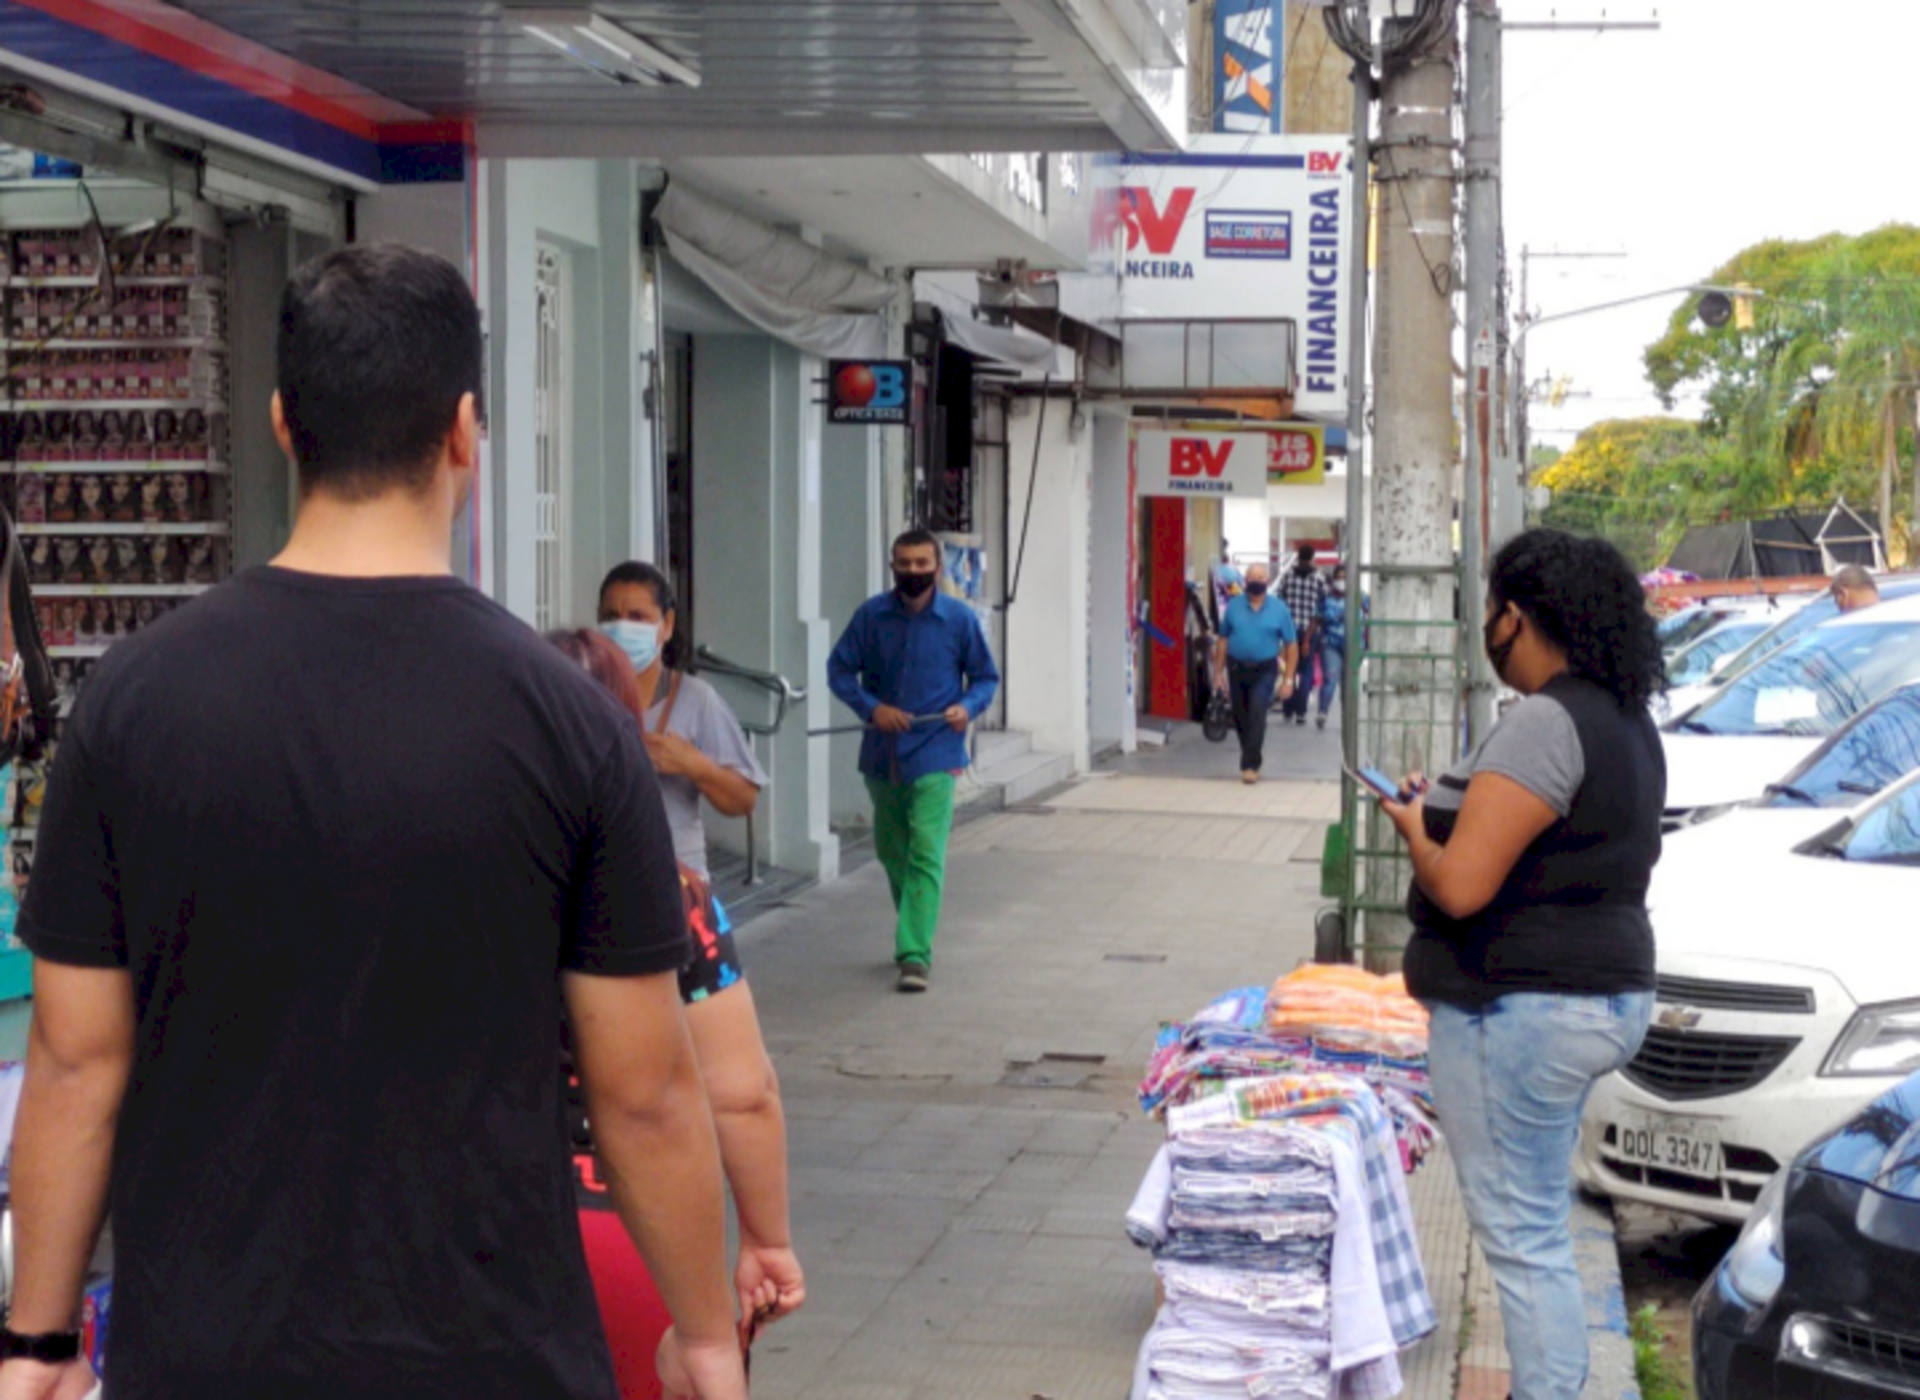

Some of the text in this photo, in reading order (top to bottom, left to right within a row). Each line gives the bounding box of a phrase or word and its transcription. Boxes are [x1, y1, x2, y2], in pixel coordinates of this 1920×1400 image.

[1309, 151, 1342, 171] BV
[1306, 188, 1339, 392] FINANCEIRA
[1170, 437, 1235, 478] BV
